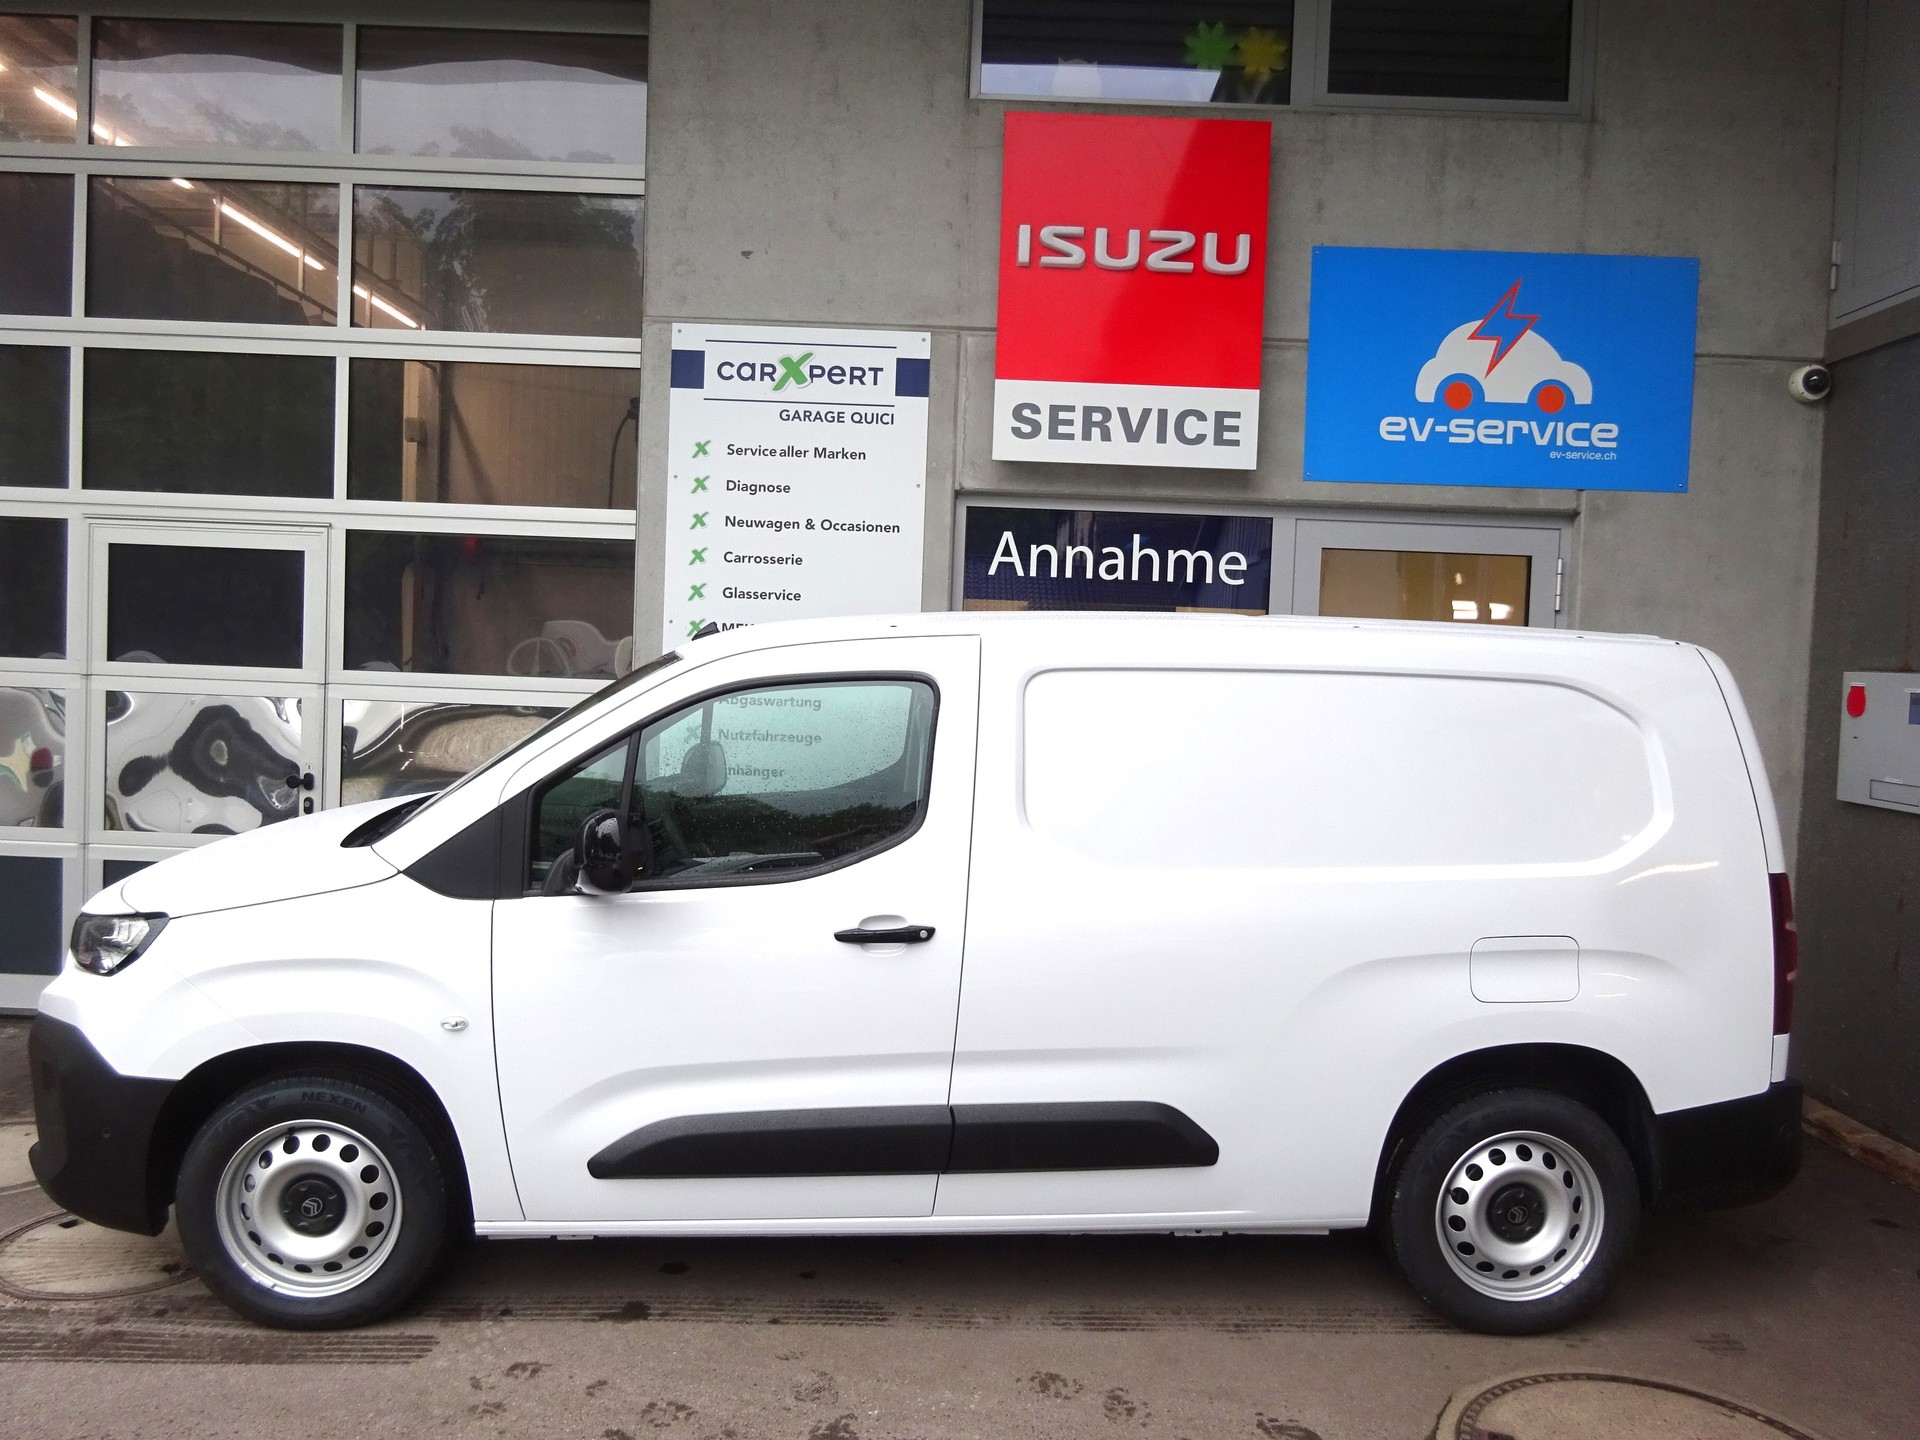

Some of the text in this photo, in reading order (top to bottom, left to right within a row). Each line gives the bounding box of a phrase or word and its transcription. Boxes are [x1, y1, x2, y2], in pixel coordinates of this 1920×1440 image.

[1017, 224, 1250, 275] ISUZU
[779, 409, 895, 425] GARAGE QUICI
[1011, 402, 1242, 447] SERVICE
[1379, 416, 1619, 448] ev-service
[813, 447, 866, 460] Marken
[1550, 450, 1617, 461] ev-service.ch
[726, 480, 791, 495] Diagnose
[725, 516, 900, 534] Neuwagen & Occasionen
[723, 551, 803, 566] Carrosserie
[988, 530, 1248, 586] Annahme
[722, 587, 801, 601] Glasservice
[718, 728, 822, 746] Nutzfahrzeuge
[727, 765, 786, 780] nhänger
[302, 1091, 368, 1114] NEXEN
